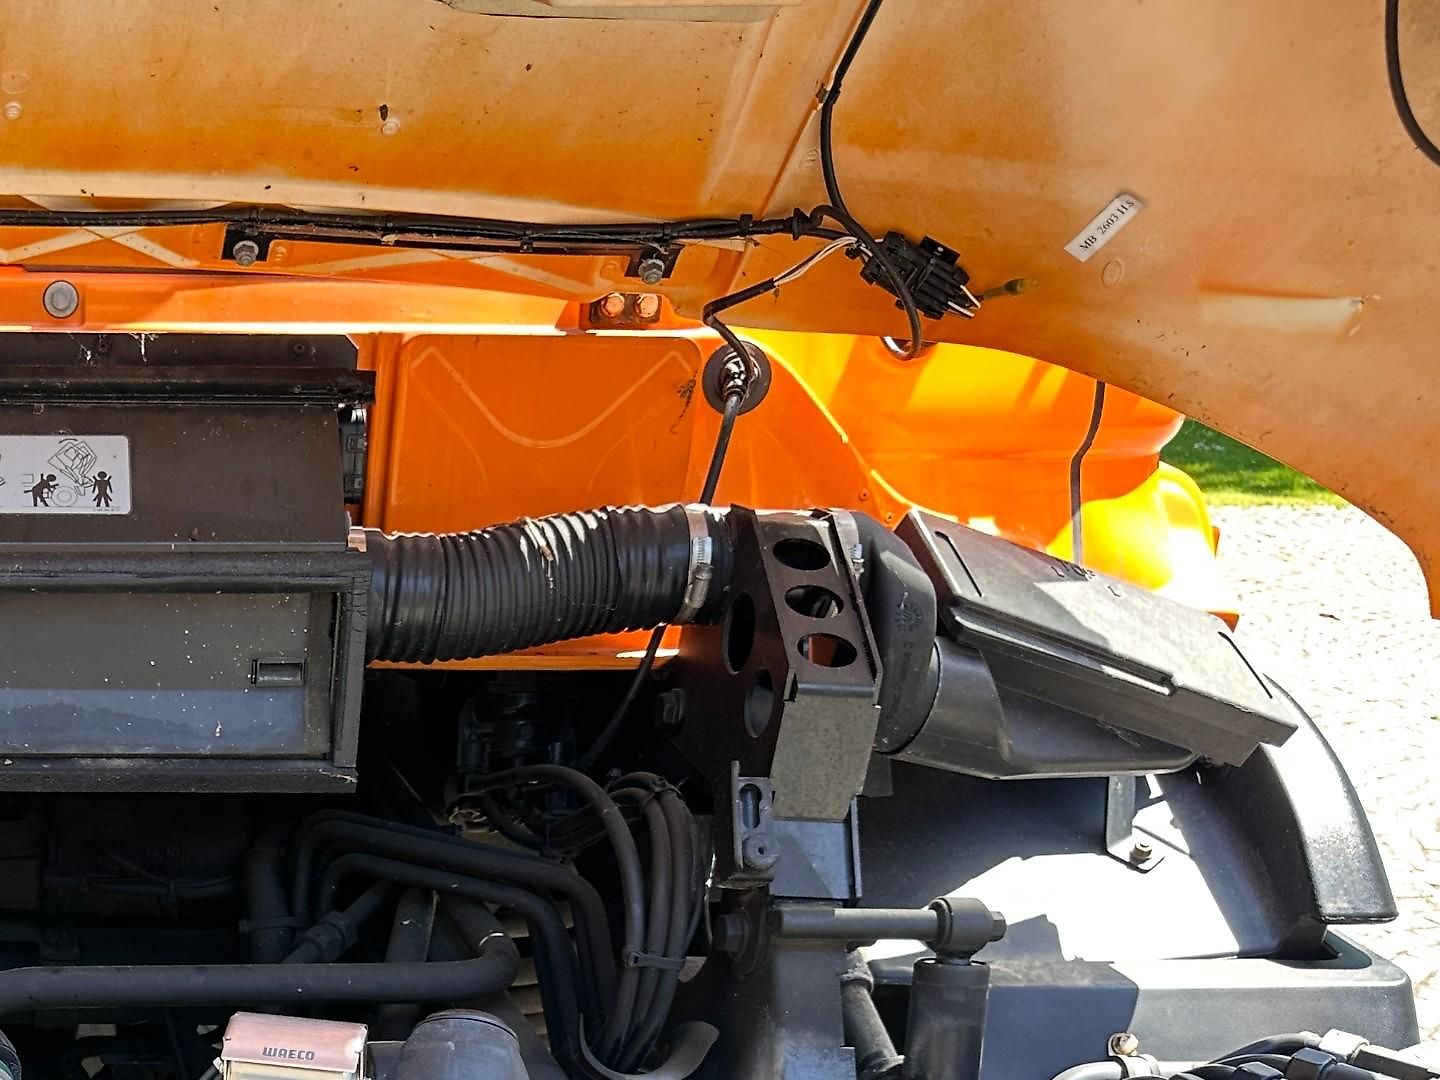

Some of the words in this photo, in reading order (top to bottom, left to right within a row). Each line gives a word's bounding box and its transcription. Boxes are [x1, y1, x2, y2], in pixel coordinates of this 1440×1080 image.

[1080, 235, 1097, 251] MB
[1097, 214, 1119, 234] 2603
[262, 1047, 315, 1061] WAECO
